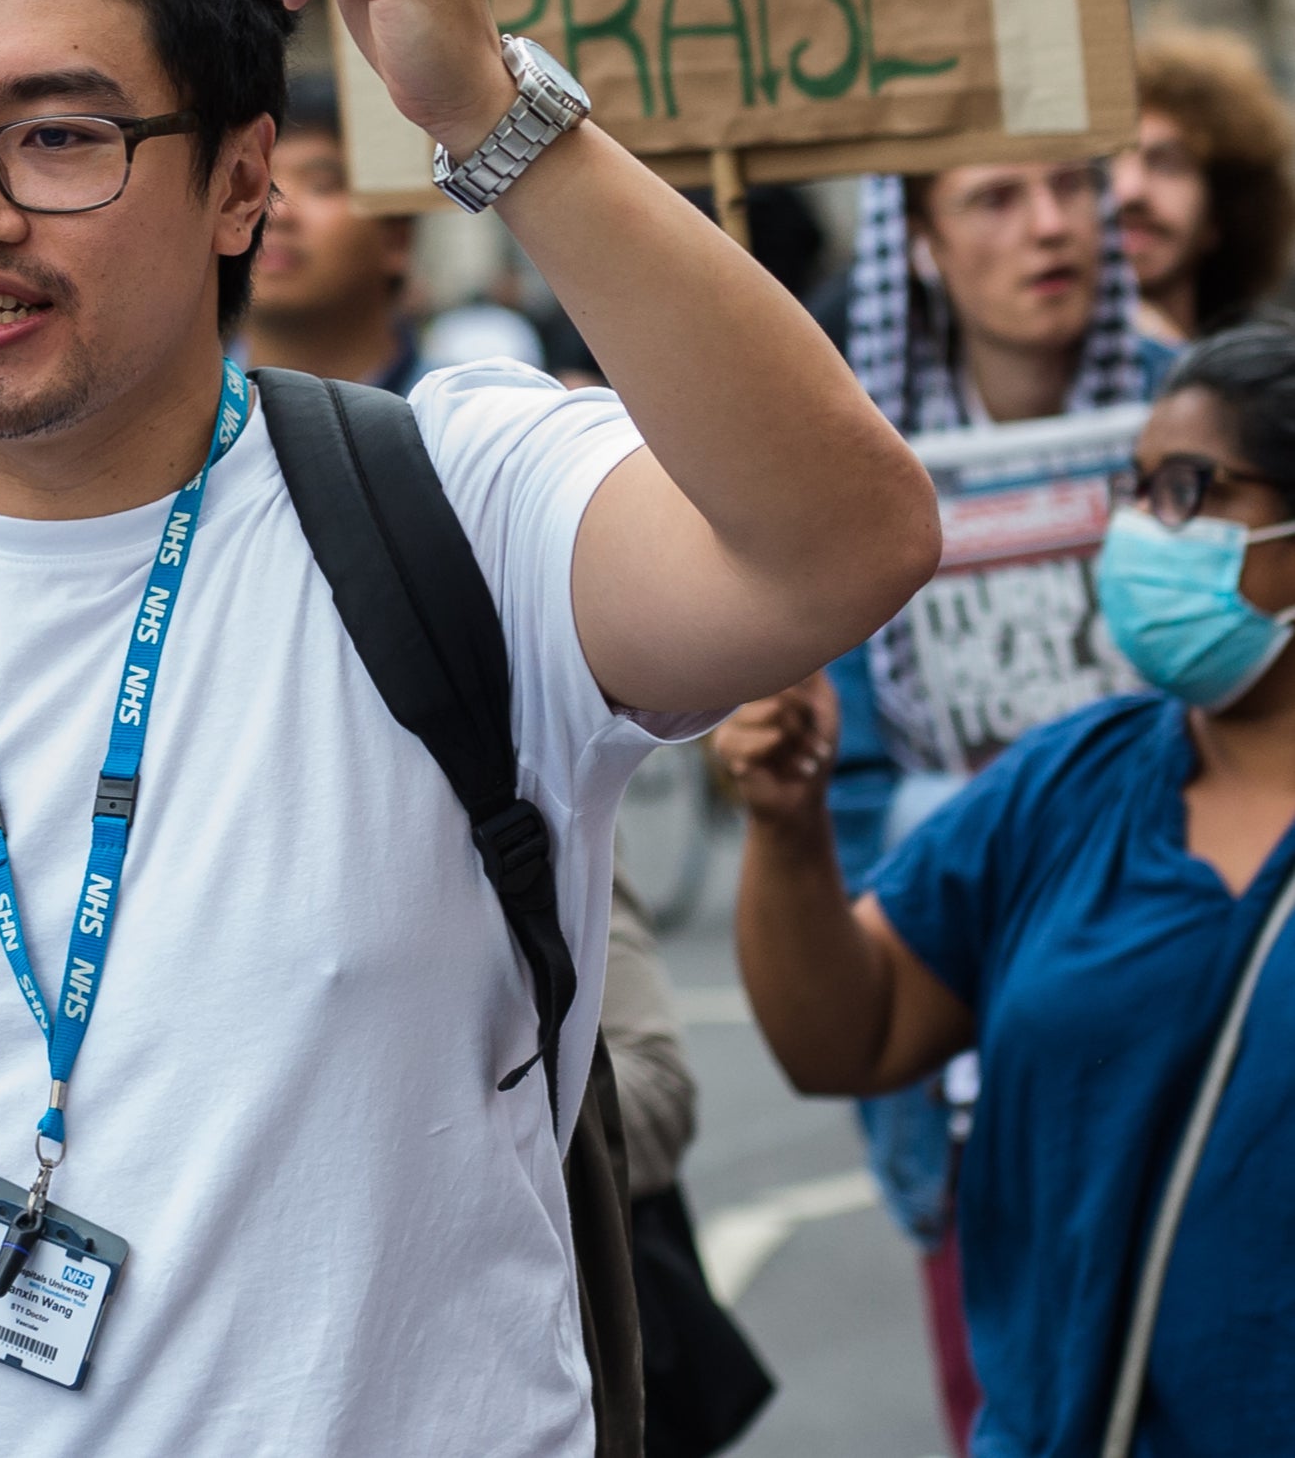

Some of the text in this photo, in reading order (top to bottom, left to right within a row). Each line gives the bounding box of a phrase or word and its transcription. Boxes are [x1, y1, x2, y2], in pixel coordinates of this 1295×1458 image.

[159, 511, 192, 567] NHS
[136, 586, 170, 645] NHS
[118, 664, 150, 727] NHS
[79, 873, 113, 938] NHS
[19, 974, 48, 1030] NHS
[64, 957, 96, 1023] NHS
[9, 1285, 73, 1319] anxin Wang
[49, 1278, 89, 1302] University
[63, 1267, 93, 1288] NHS
[25, 1309, 49, 1323] Doctor
